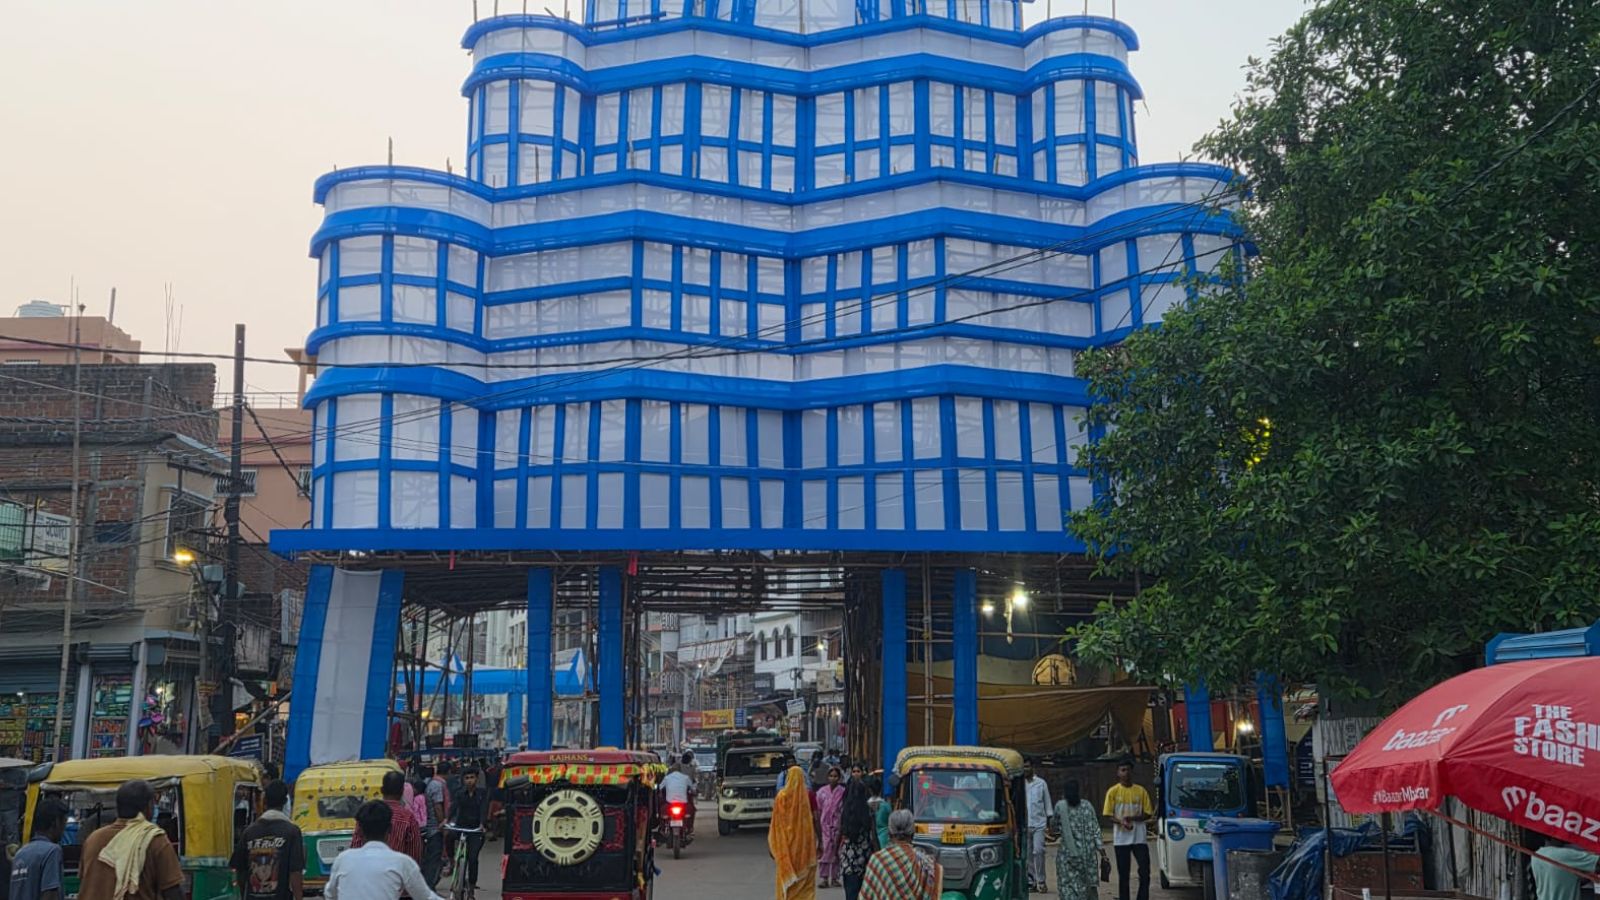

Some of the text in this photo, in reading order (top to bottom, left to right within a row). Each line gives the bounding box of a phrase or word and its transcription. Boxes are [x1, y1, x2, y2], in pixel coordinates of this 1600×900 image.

[1531, 704, 1573, 720] THE
[1514, 716, 1600, 751] FASH
[1513, 737, 1585, 767] STORE
